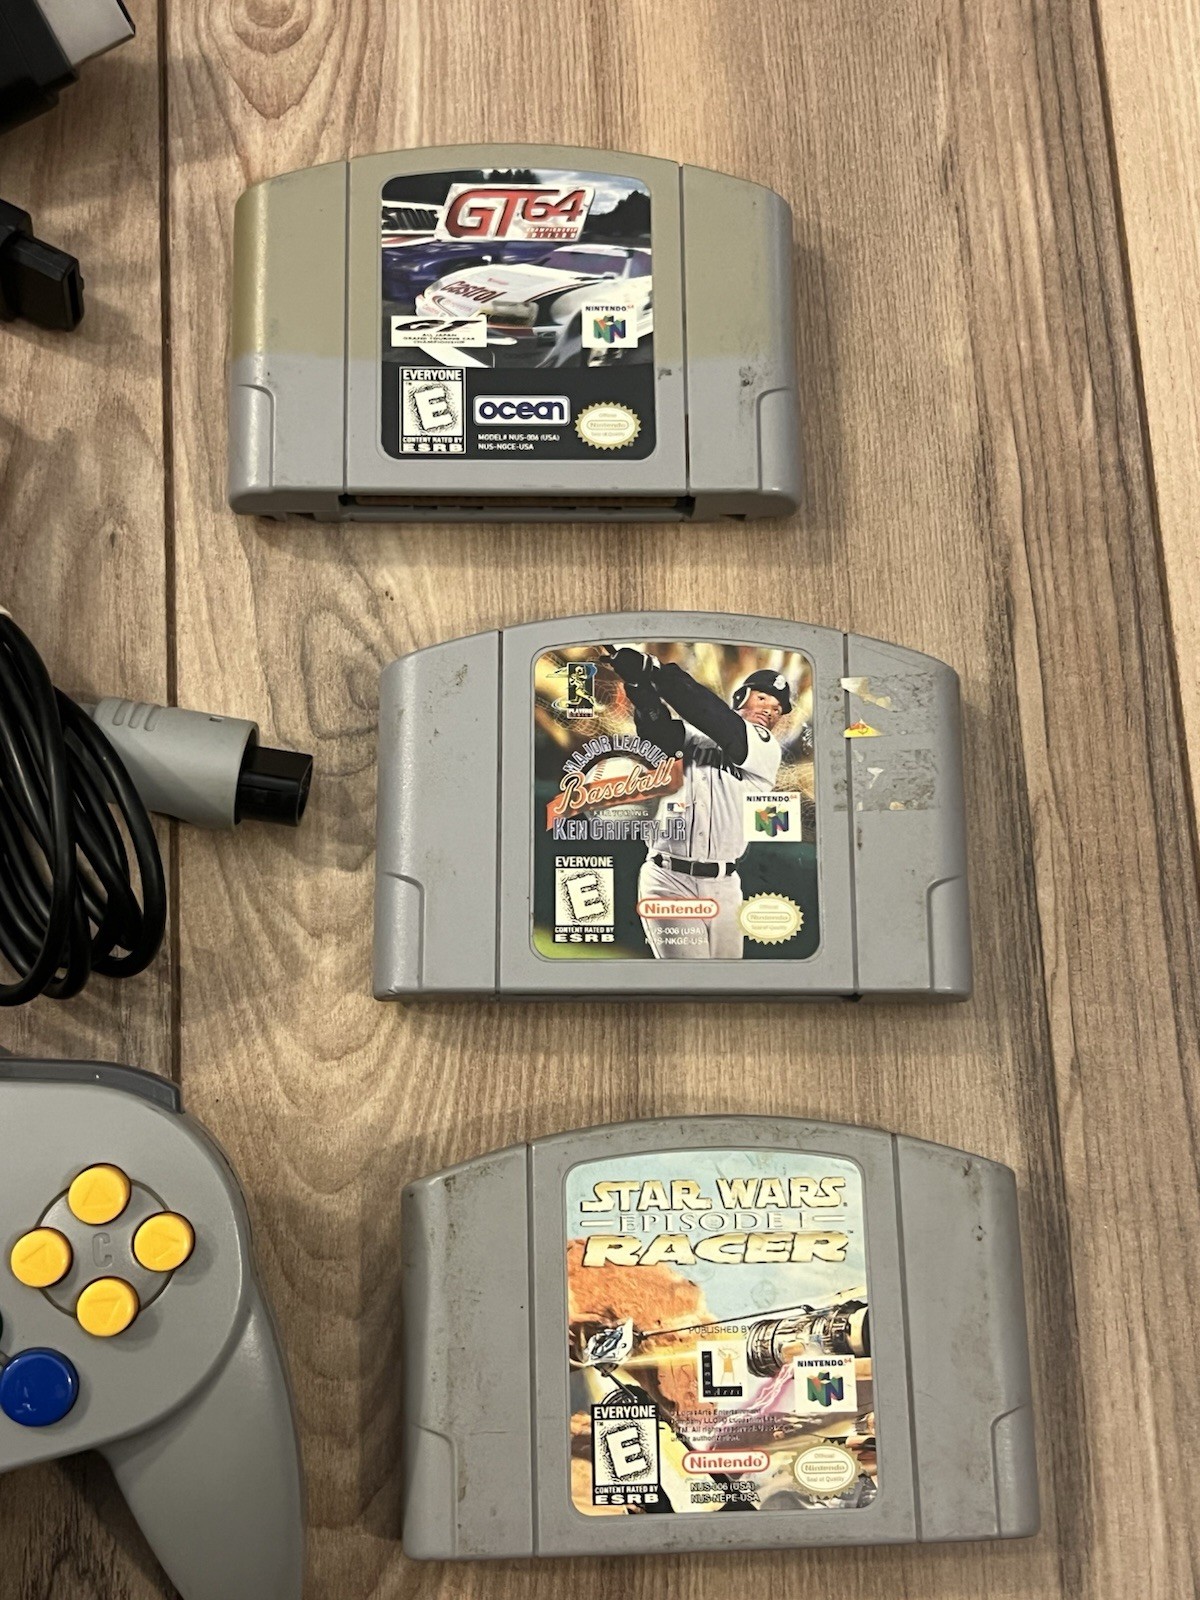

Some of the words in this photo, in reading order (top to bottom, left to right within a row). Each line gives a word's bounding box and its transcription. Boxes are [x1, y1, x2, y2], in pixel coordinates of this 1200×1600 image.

[403, 369, 462, 380] EVERYONE
[479, 401, 565, 420] ocean
[403, 443, 463, 452] ESRB
[563, 735, 612, 774] MAJOR
[613, 734, 668, 769] LEAGUE
[553, 757, 676, 814] Baseball
[552, 817, 589, 840] KEN
[589, 817, 660, 840] GRIFFEY
[660, 816, 686, 840] JR
[555, 856, 614, 868] EVERYONE
[644, 903, 713, 915] Nintendo
[555, 934, 614, 943] ESRB
[645, 937, 709, 946] NS-NKGE-USA
[580, 1179, 712, 1212] STAR
[716, 1176, 846, 1209] WARS
[618, 1211, 783, 1234] EPISODE
[800, 1211, 808, 1231] I
[92, 1231, 113, 1268] C
[582, 1230, 850, 1268] RACER
[689, 1326, 738, 1334] PUBLISHED
[797, 1359, 843, 1367] NINTENDO
[594, 1405, 656, 1419] EVERYONE
[690, 1456, 763, 1469] Nintendo
[804, 1464, 846, 1472] Nintendo
[595, 1486, 625, 1494] CONTENT
[626, 1485, 648, 1493] RATED
[690, 1482, 728, 1491] NUS-006
[729, 1480, 755, 1492] (USA)
[595, 1493, 659, 1505] ESRB
[691, 1491, 761, 1503] NUS-NEPE-USA
